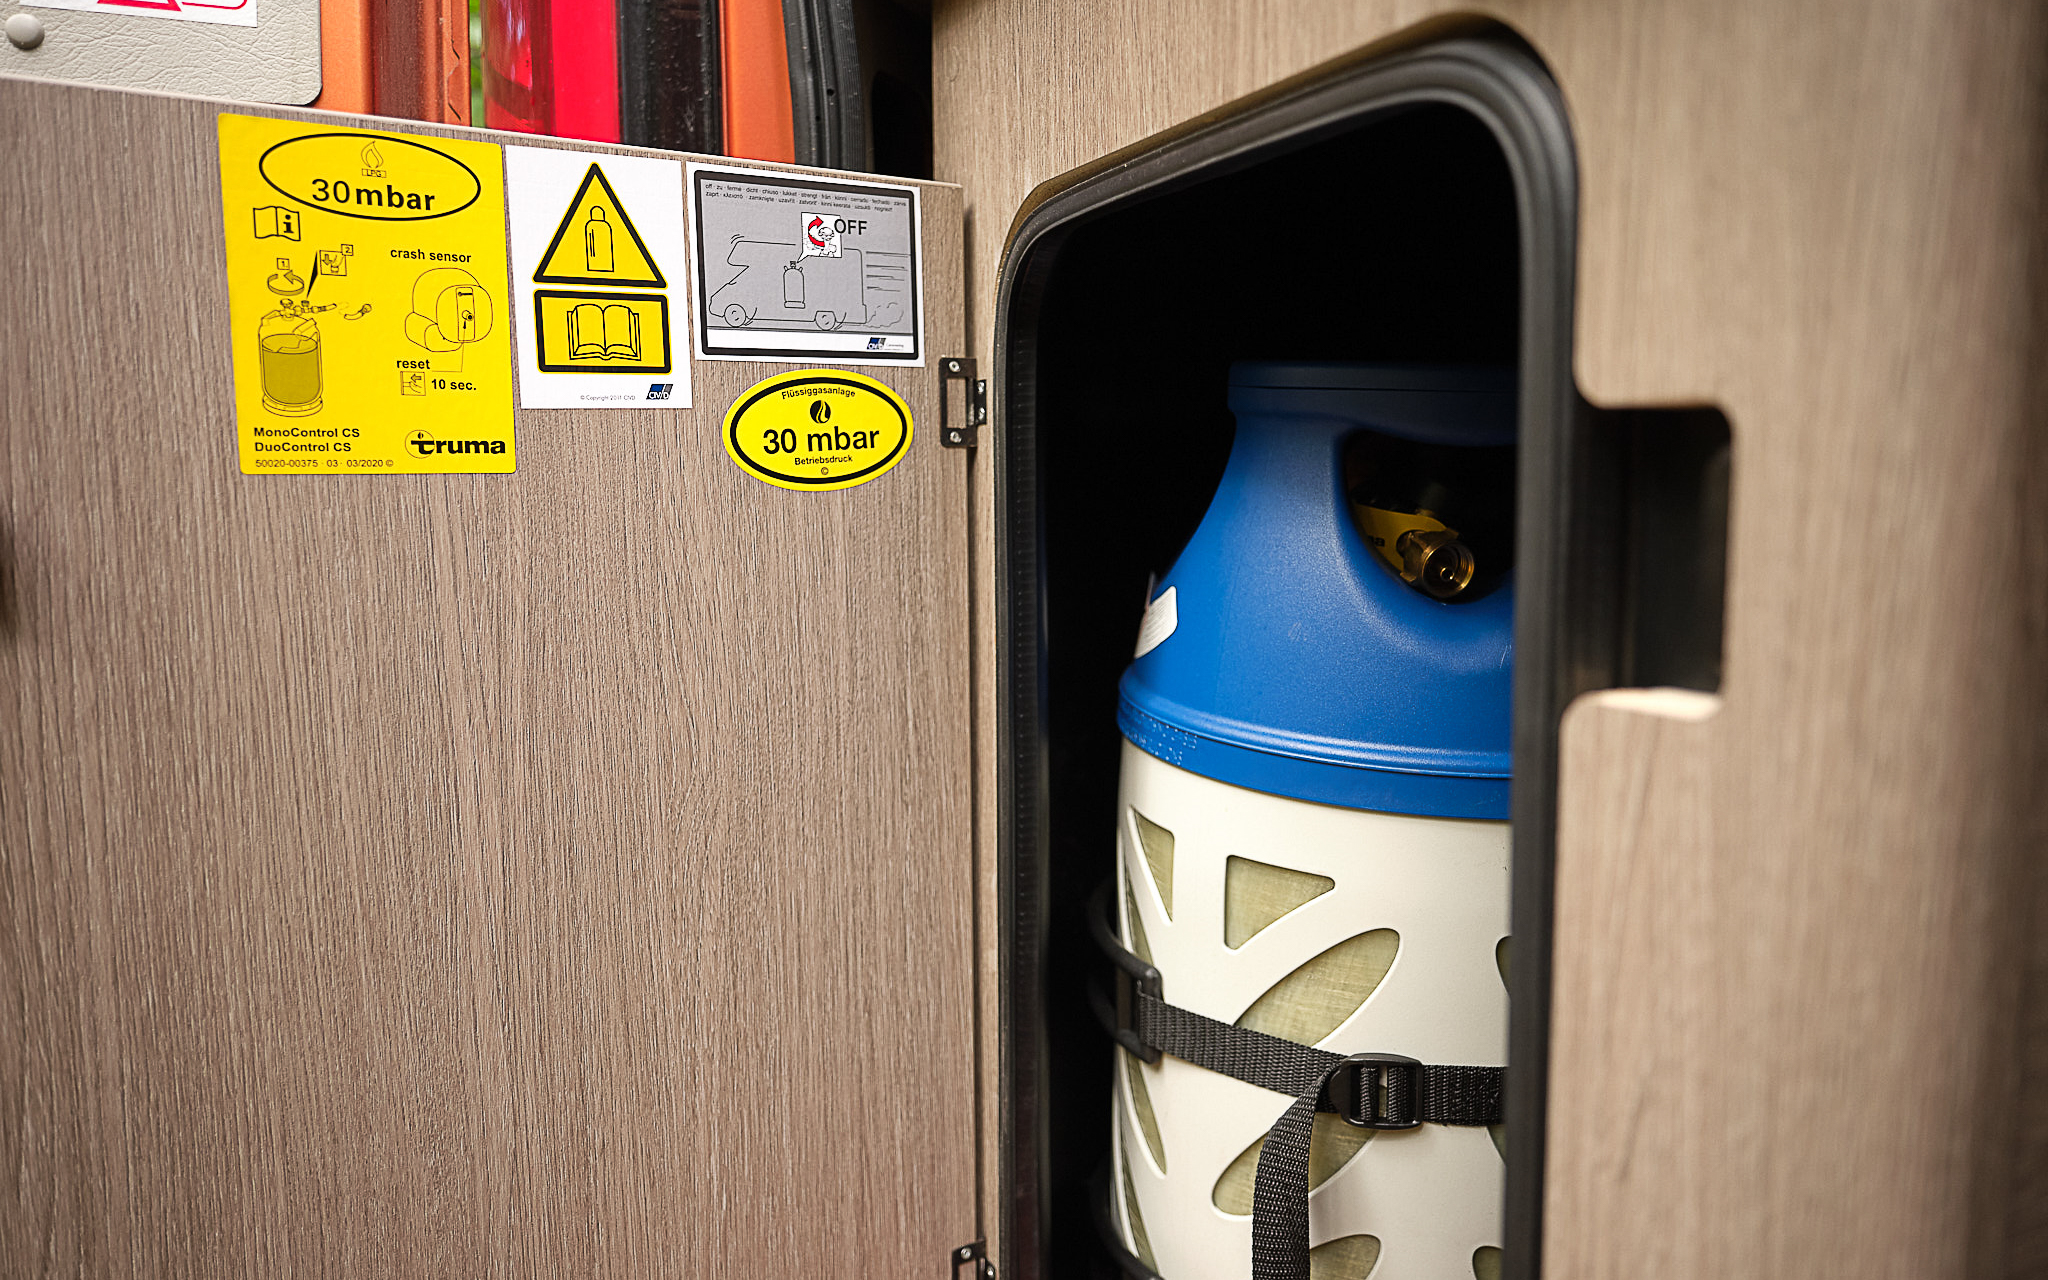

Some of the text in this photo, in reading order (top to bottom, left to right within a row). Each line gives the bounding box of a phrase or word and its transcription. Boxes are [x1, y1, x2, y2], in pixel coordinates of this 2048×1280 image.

[366, 169, 382, 178] LPG
[311, 178, 436, 211] 30 mbar
[834, 218, 868, 235] OFF
[390, 248, 472, 263] crash sensor
[396, 359, 431, 370] reset
[431, 378, 477, 391] 10 sec.
[781, 386, 856, 400] Flüssiggasanlage
[254, 427, 360, 438] MonoControl CS
[410, 438, 506, 455] truma
[763, 425, 880, 455] 30 mbar
[254, 442, 351, 452] DuoControl CS
[255, 459, 319, 468] 50020-00375
[346, 459, 384, 468] 03/2020
[794, 454, 853, 466] Betriebsdruck
